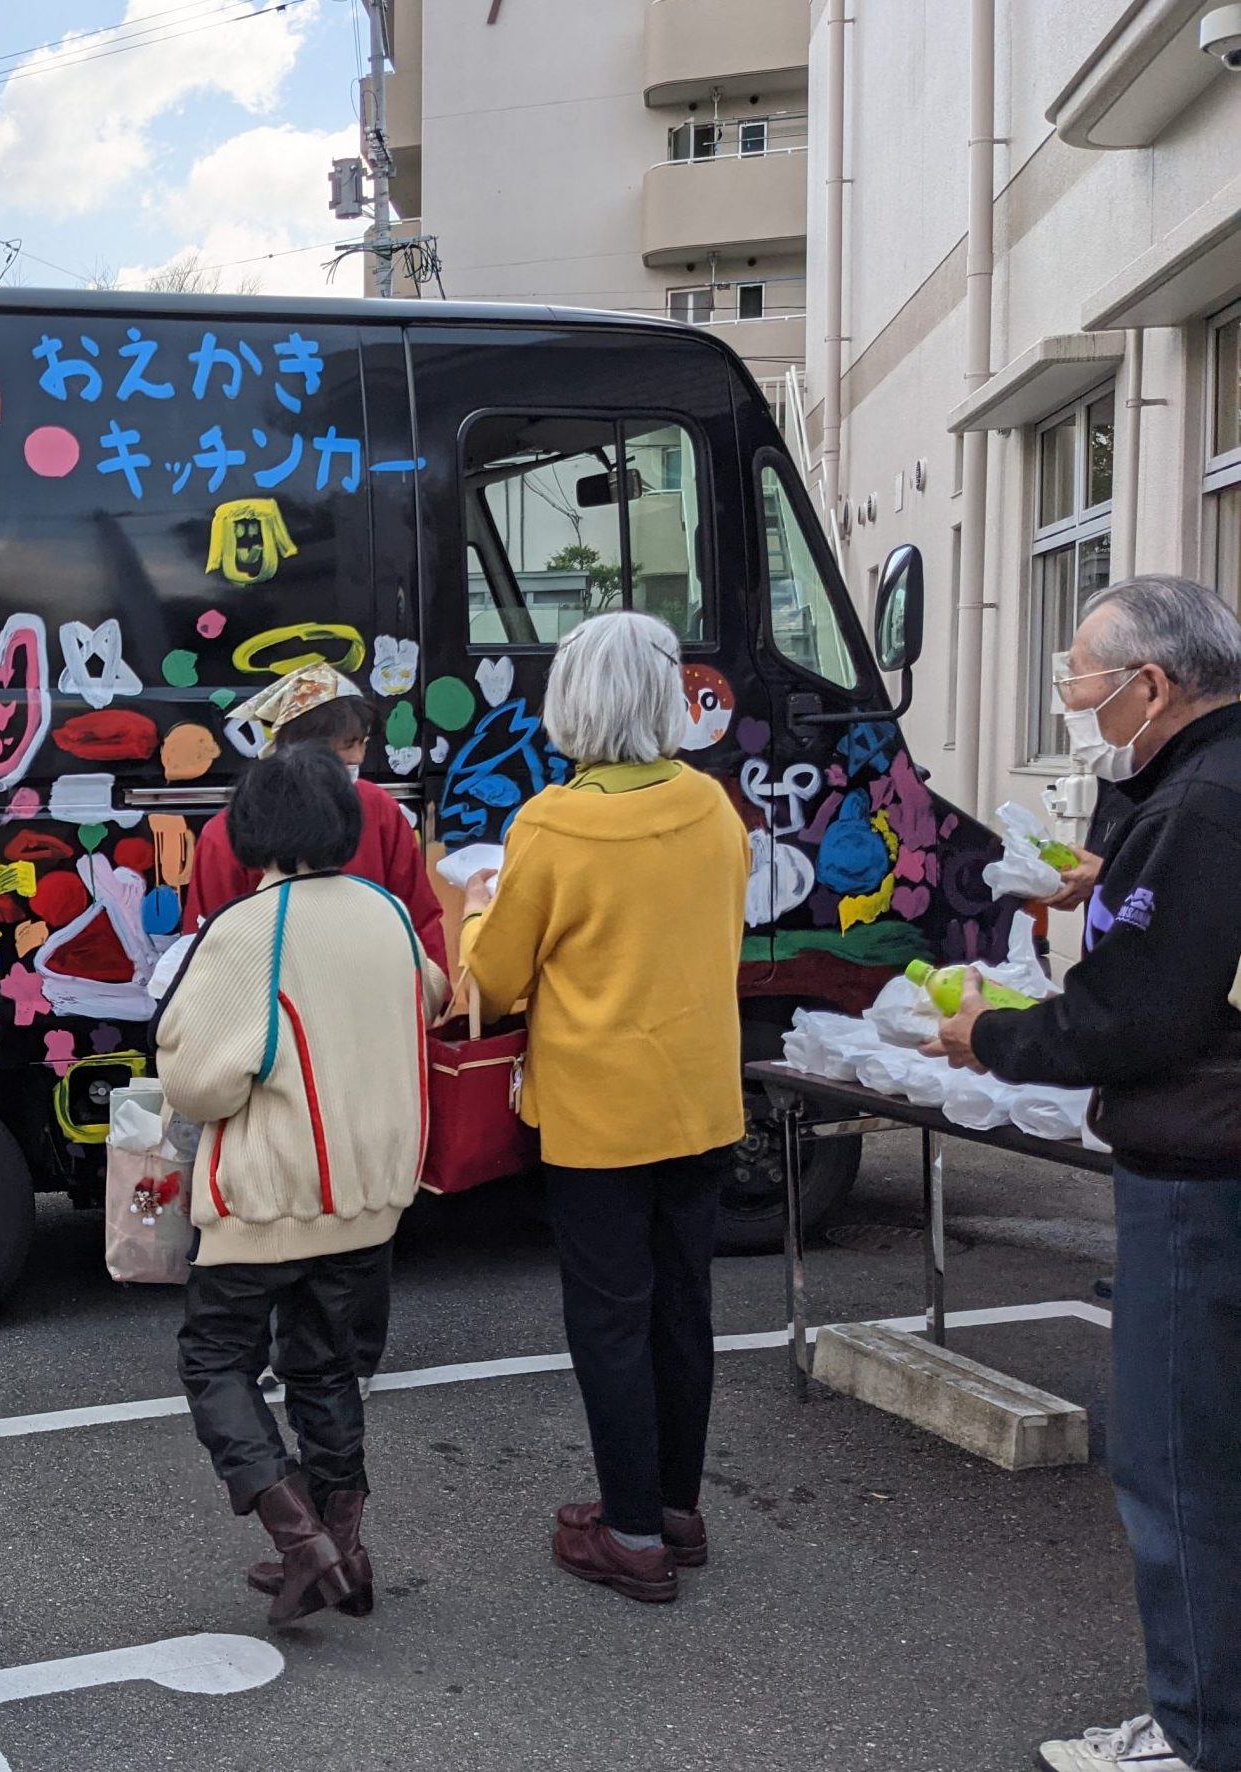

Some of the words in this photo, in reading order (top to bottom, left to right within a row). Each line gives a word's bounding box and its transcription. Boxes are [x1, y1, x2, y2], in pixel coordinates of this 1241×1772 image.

[32, 327, 325, 414] おえかき
[96, 419, 427, 501] キッチンカー
